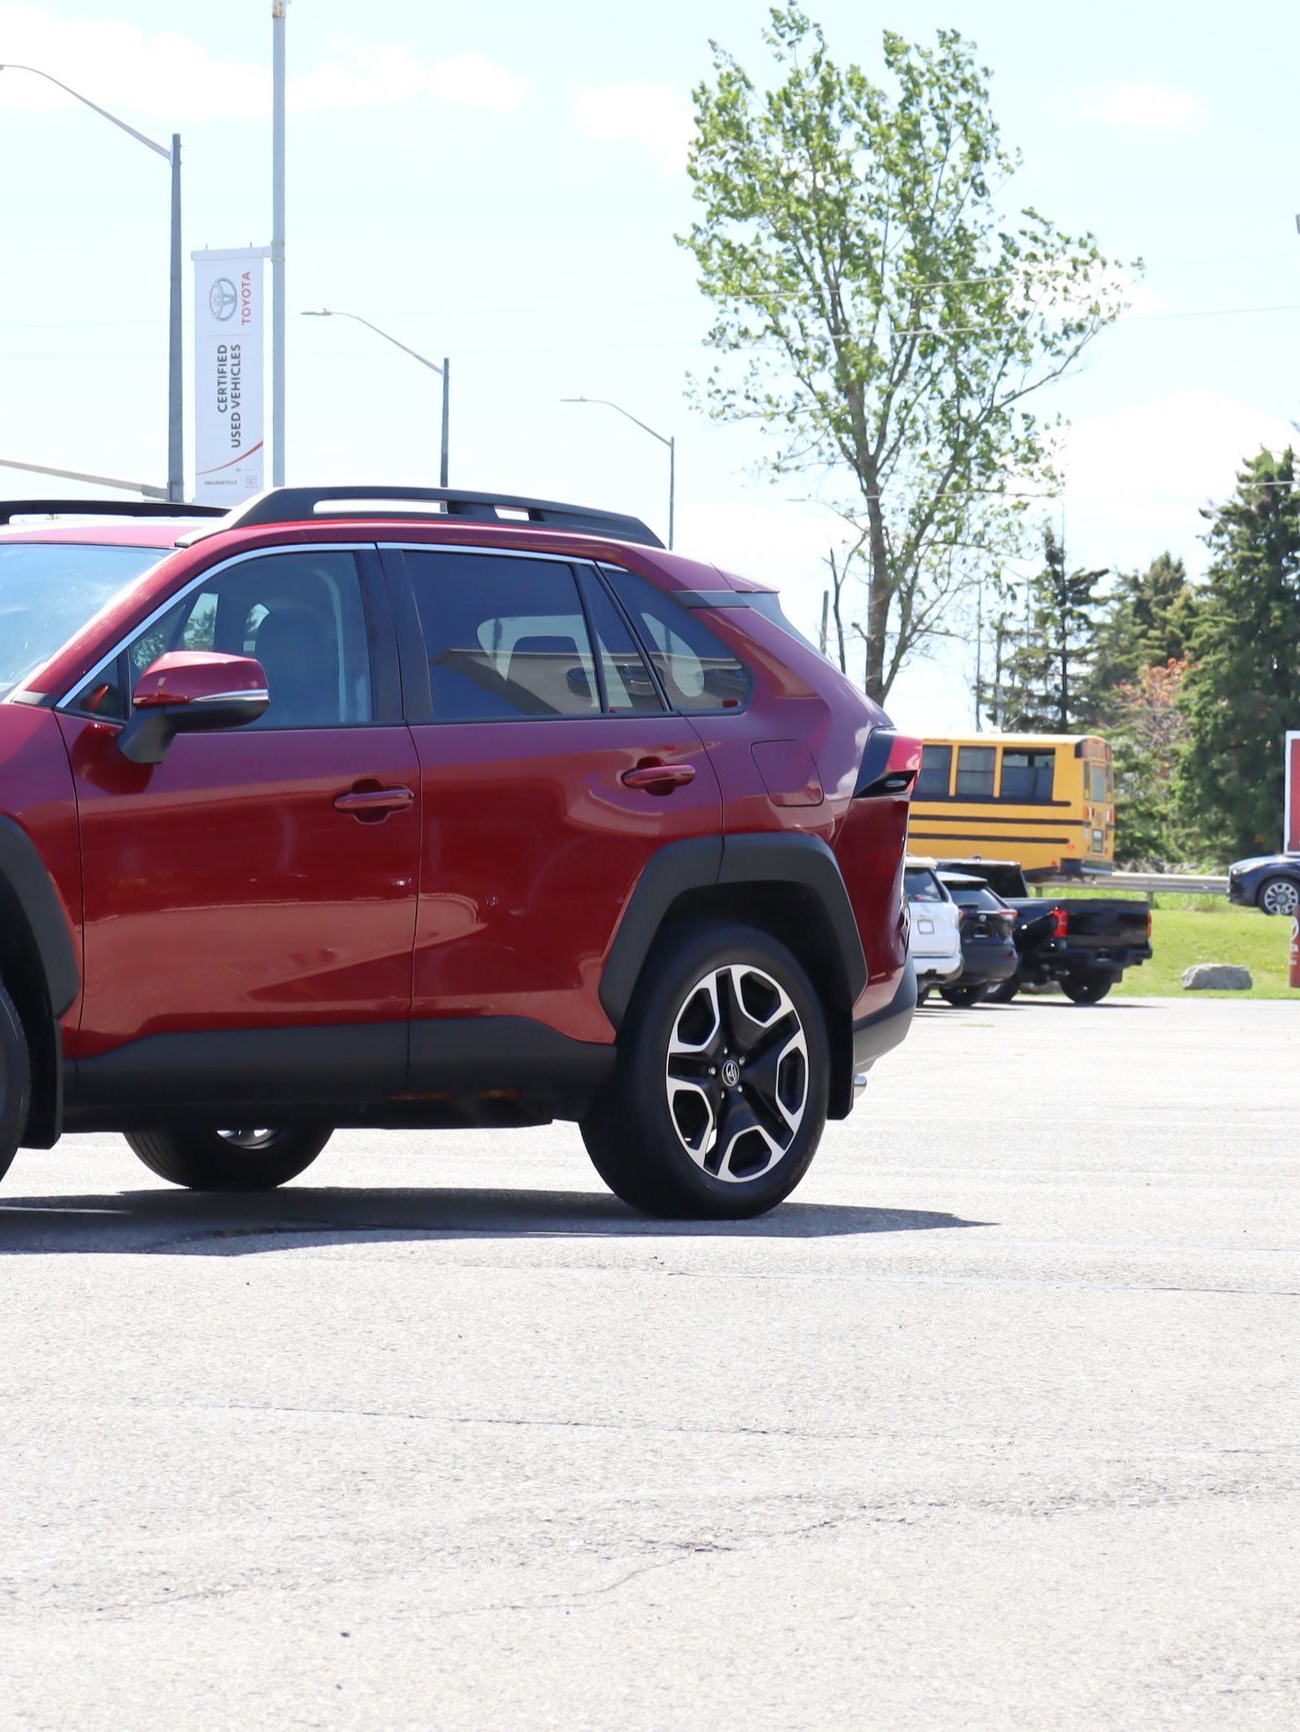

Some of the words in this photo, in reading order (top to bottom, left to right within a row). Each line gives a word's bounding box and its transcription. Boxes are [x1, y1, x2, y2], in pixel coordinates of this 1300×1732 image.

[241, 271, 251, 326] TOYOTA
[217, 344, 228, 413] CERTIFIED
[230, 343, 241, 410] VEHICLES
[231, 412, 241, 448] USED
